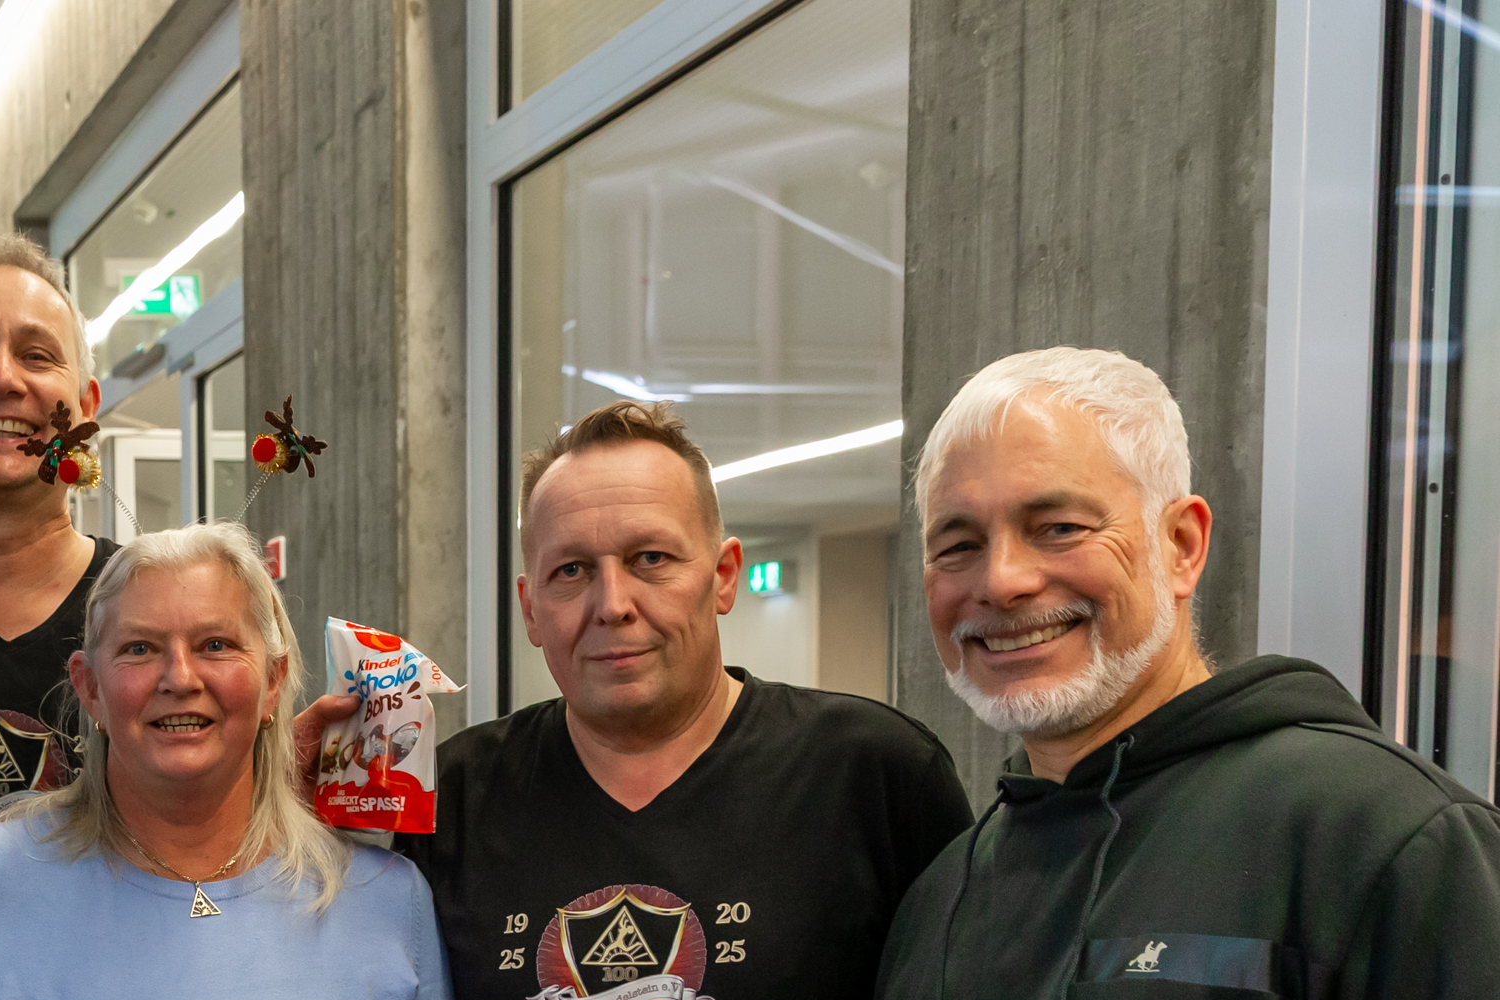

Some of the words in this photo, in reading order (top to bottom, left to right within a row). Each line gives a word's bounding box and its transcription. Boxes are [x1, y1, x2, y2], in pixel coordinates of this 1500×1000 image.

[359, 796, 406, 812] SPASS!
[503, 912, 529, 935] 19
[715, 901, 751, 925] 20
[499, 947, 526, 970] 25
[714, 938, 747, 964] 25
[601, 966, 639, 982] 100
